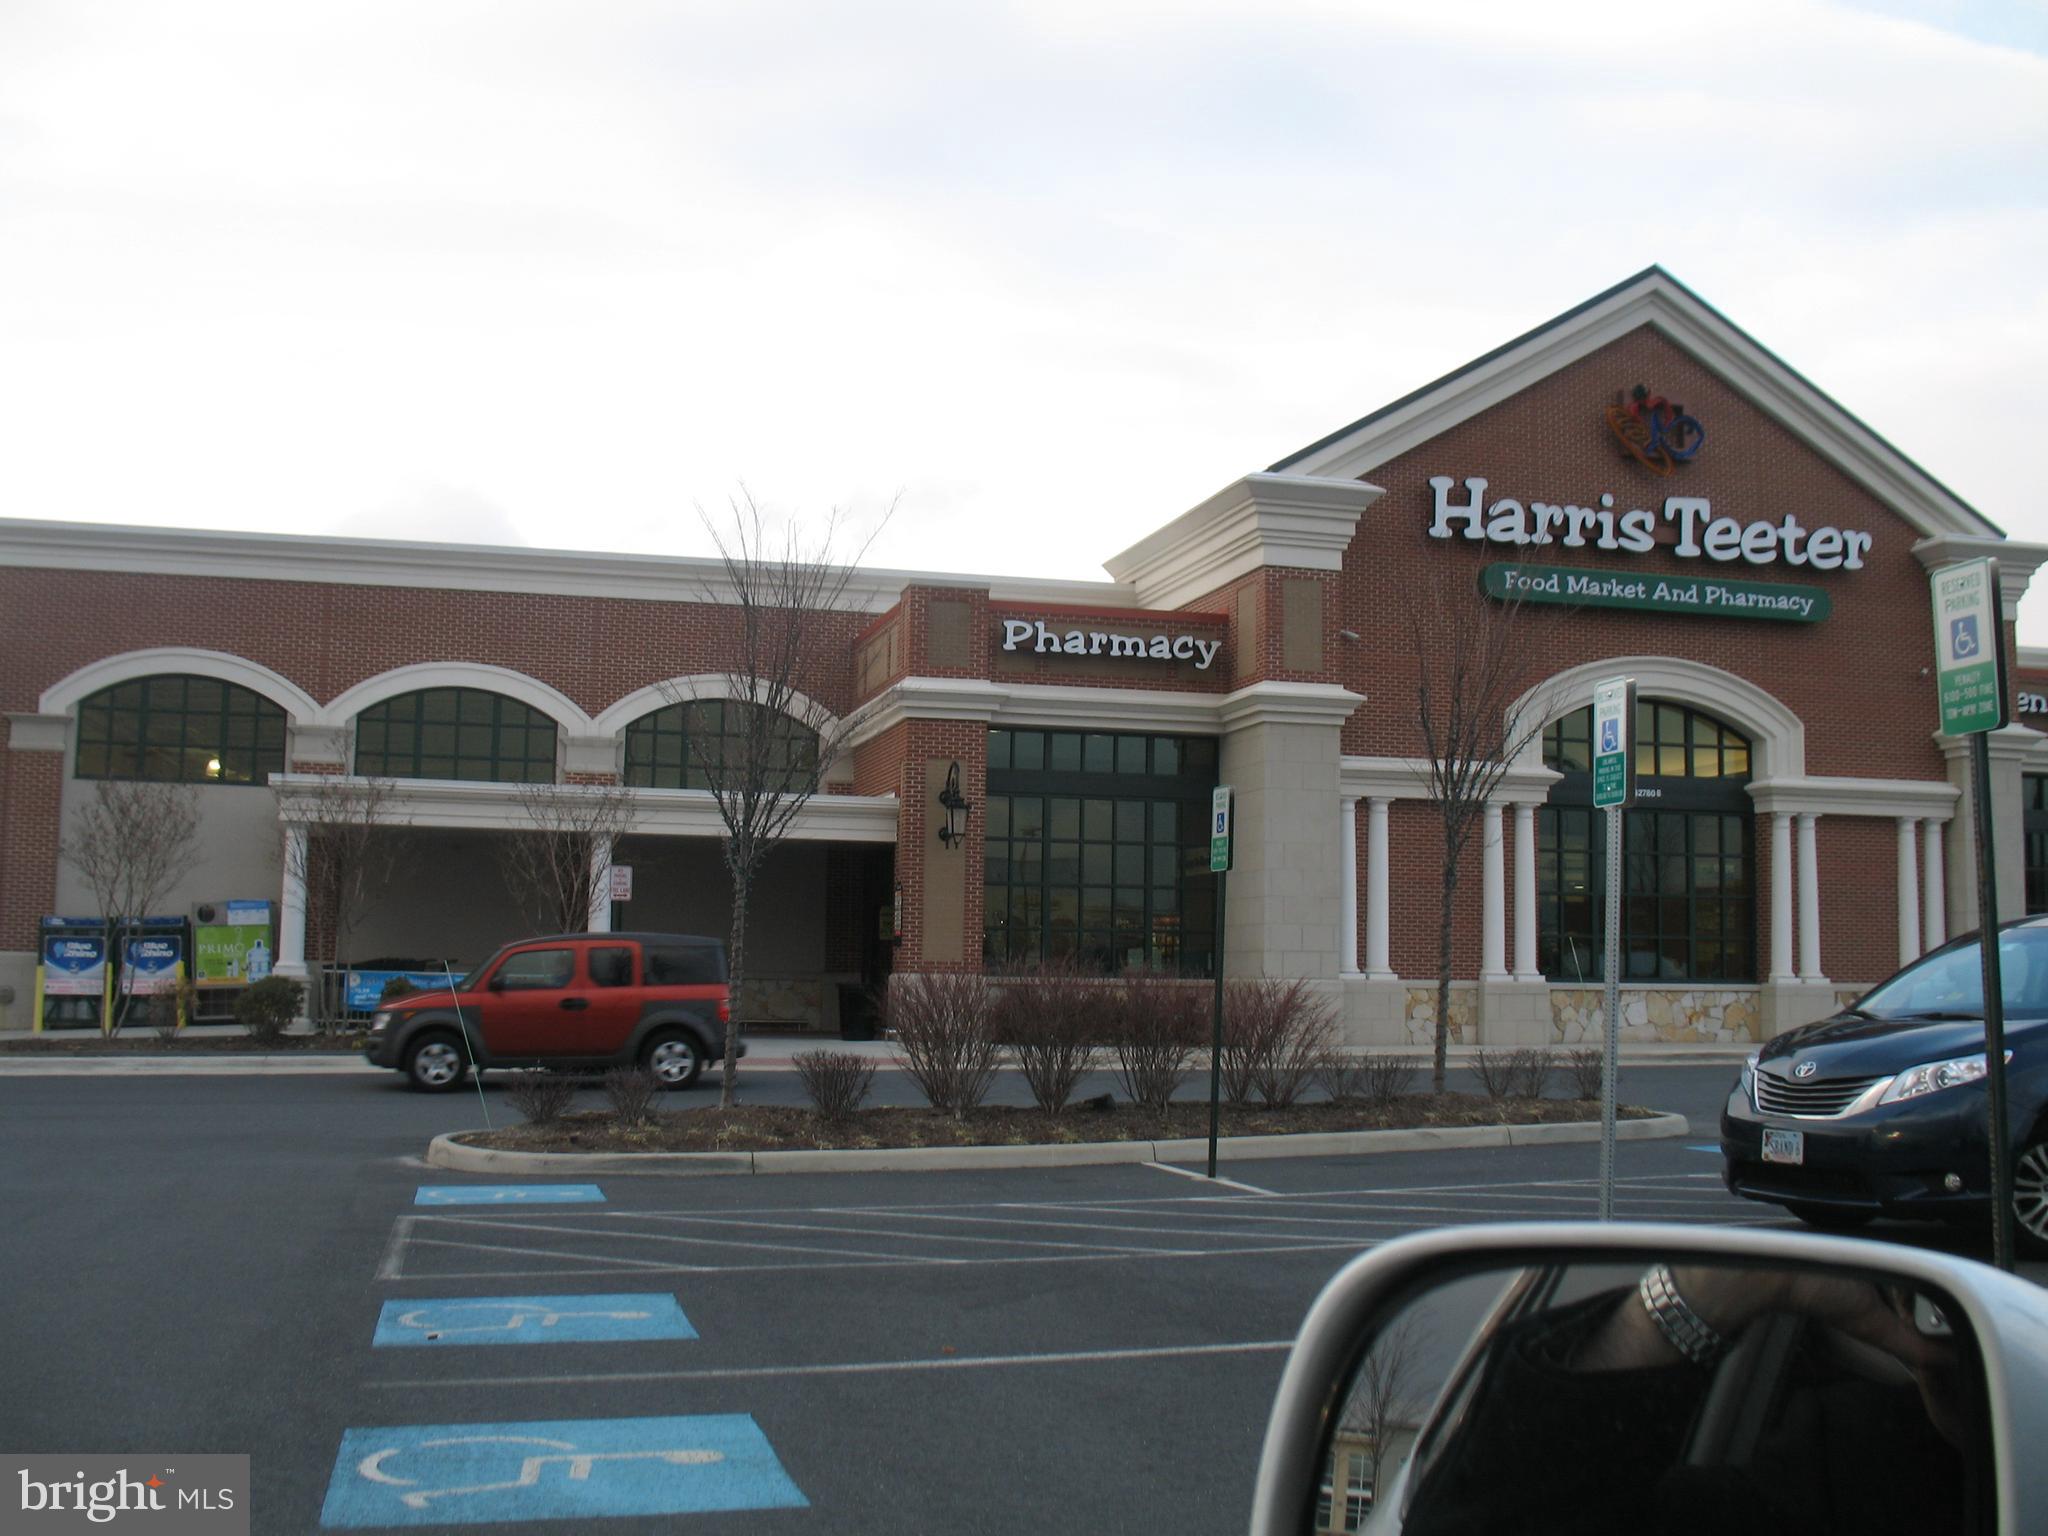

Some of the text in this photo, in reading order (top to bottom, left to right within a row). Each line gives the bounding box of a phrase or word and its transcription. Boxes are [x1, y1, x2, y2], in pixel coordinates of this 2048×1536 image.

[1428, 476, 1873, 570] Harris Teeter
[1504, 571, 1814, 615] Food Market And Pharmacy
[1002, 619, 1222, 670] Pharmacy
